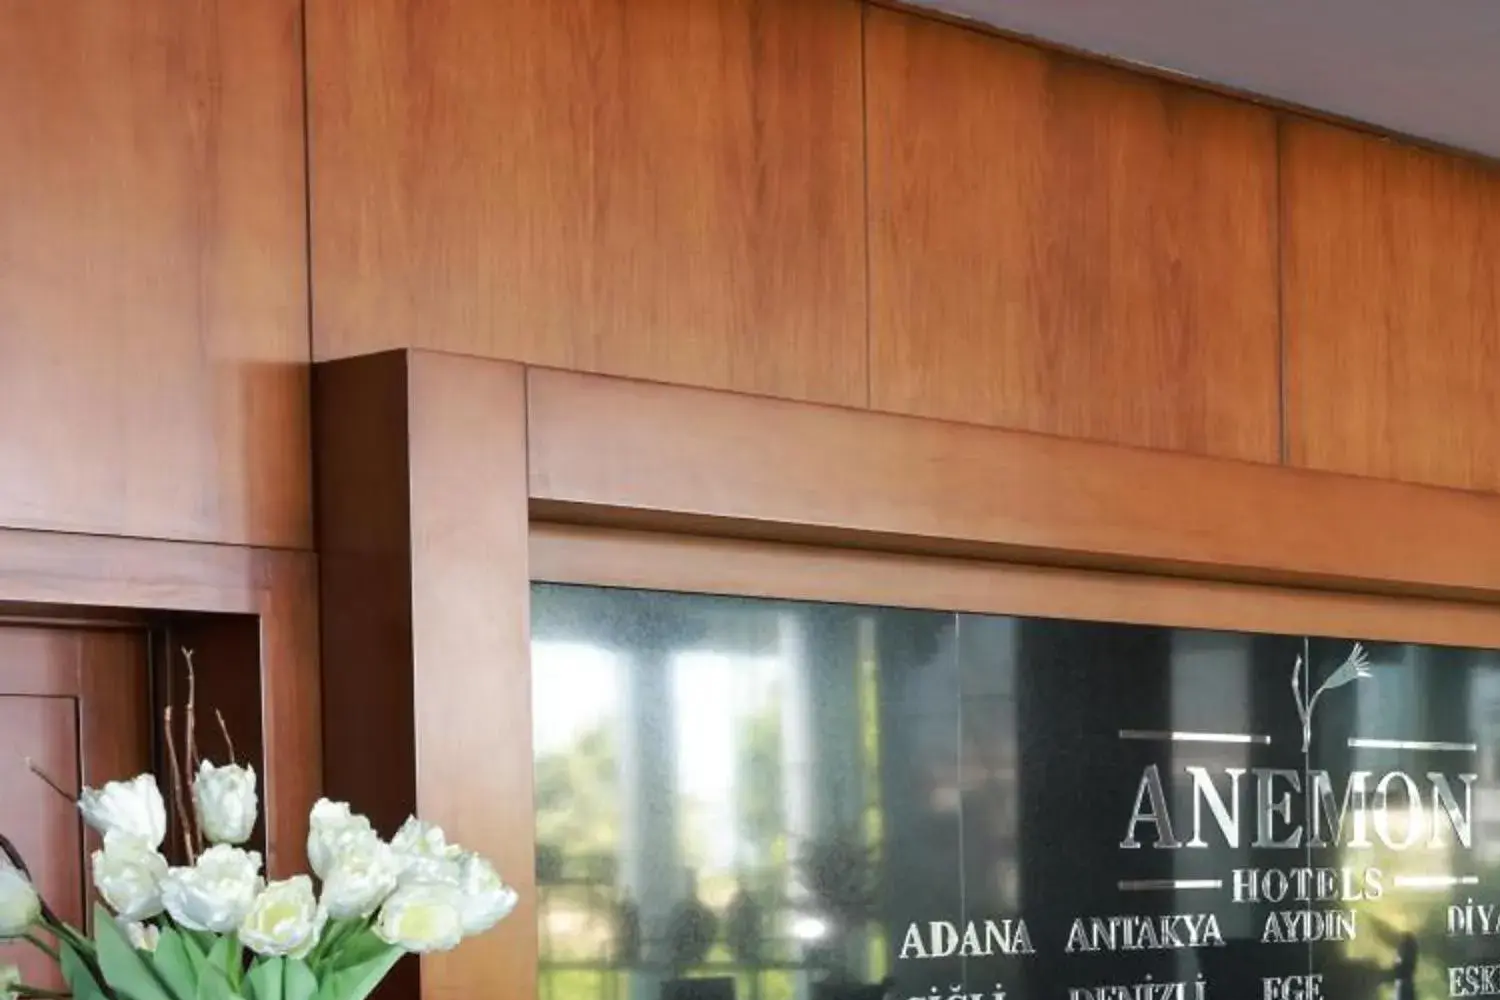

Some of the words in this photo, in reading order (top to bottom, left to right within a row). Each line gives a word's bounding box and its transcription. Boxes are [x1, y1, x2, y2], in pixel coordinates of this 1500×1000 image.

[1119, 763, 1478, 849] ANEMON
[1232, 866, 1384, 902] HOTELS
[899, 918, 1036, 958] ADANA
[1064, 913, 1227, 954] ANTAKYA
[1261, 909, 1357, 943] AYDIN
